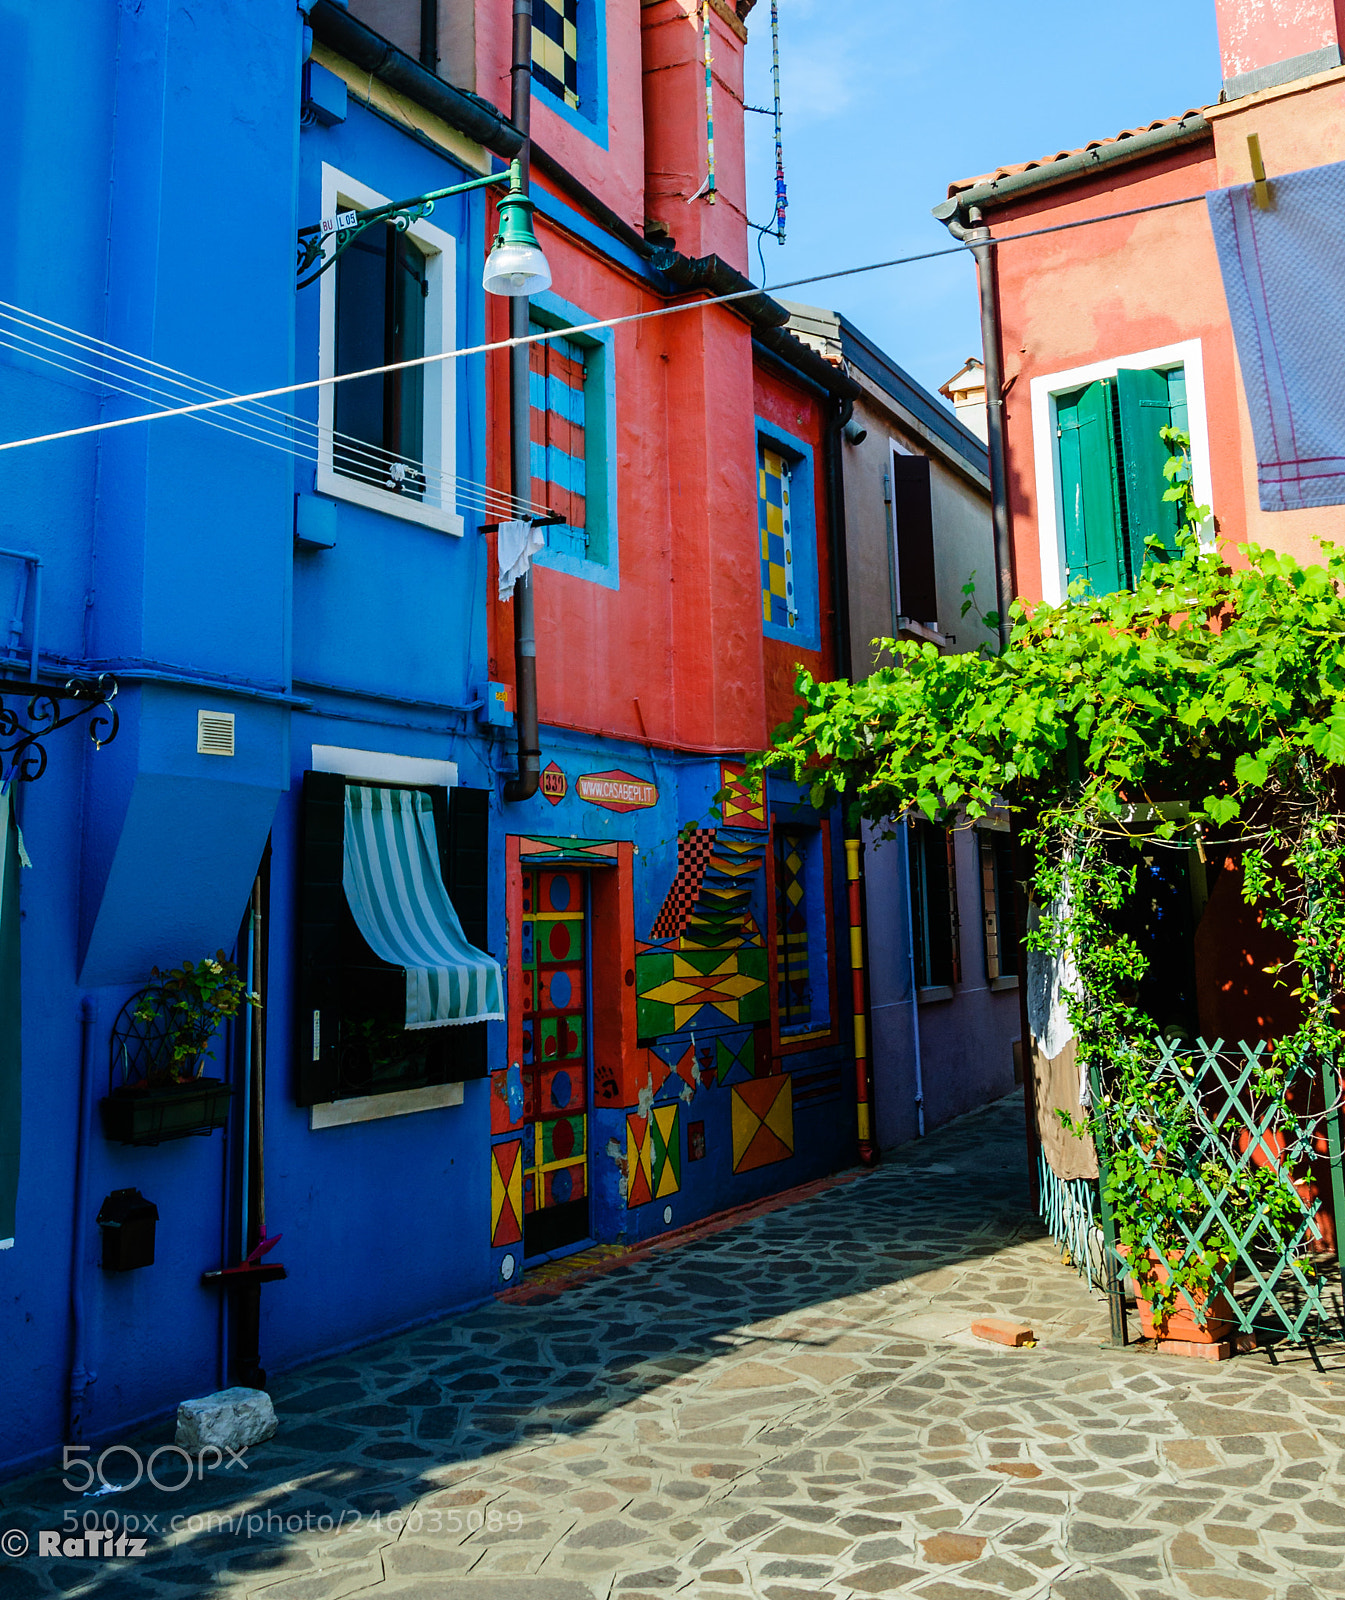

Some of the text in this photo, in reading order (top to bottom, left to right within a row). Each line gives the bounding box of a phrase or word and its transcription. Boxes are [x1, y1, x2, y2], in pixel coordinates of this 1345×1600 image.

[322, 219, 333, 231] BU
[338, 216, 345, 227] L
[580, 780, 653, 802] WWW.CASABEPI.IT
